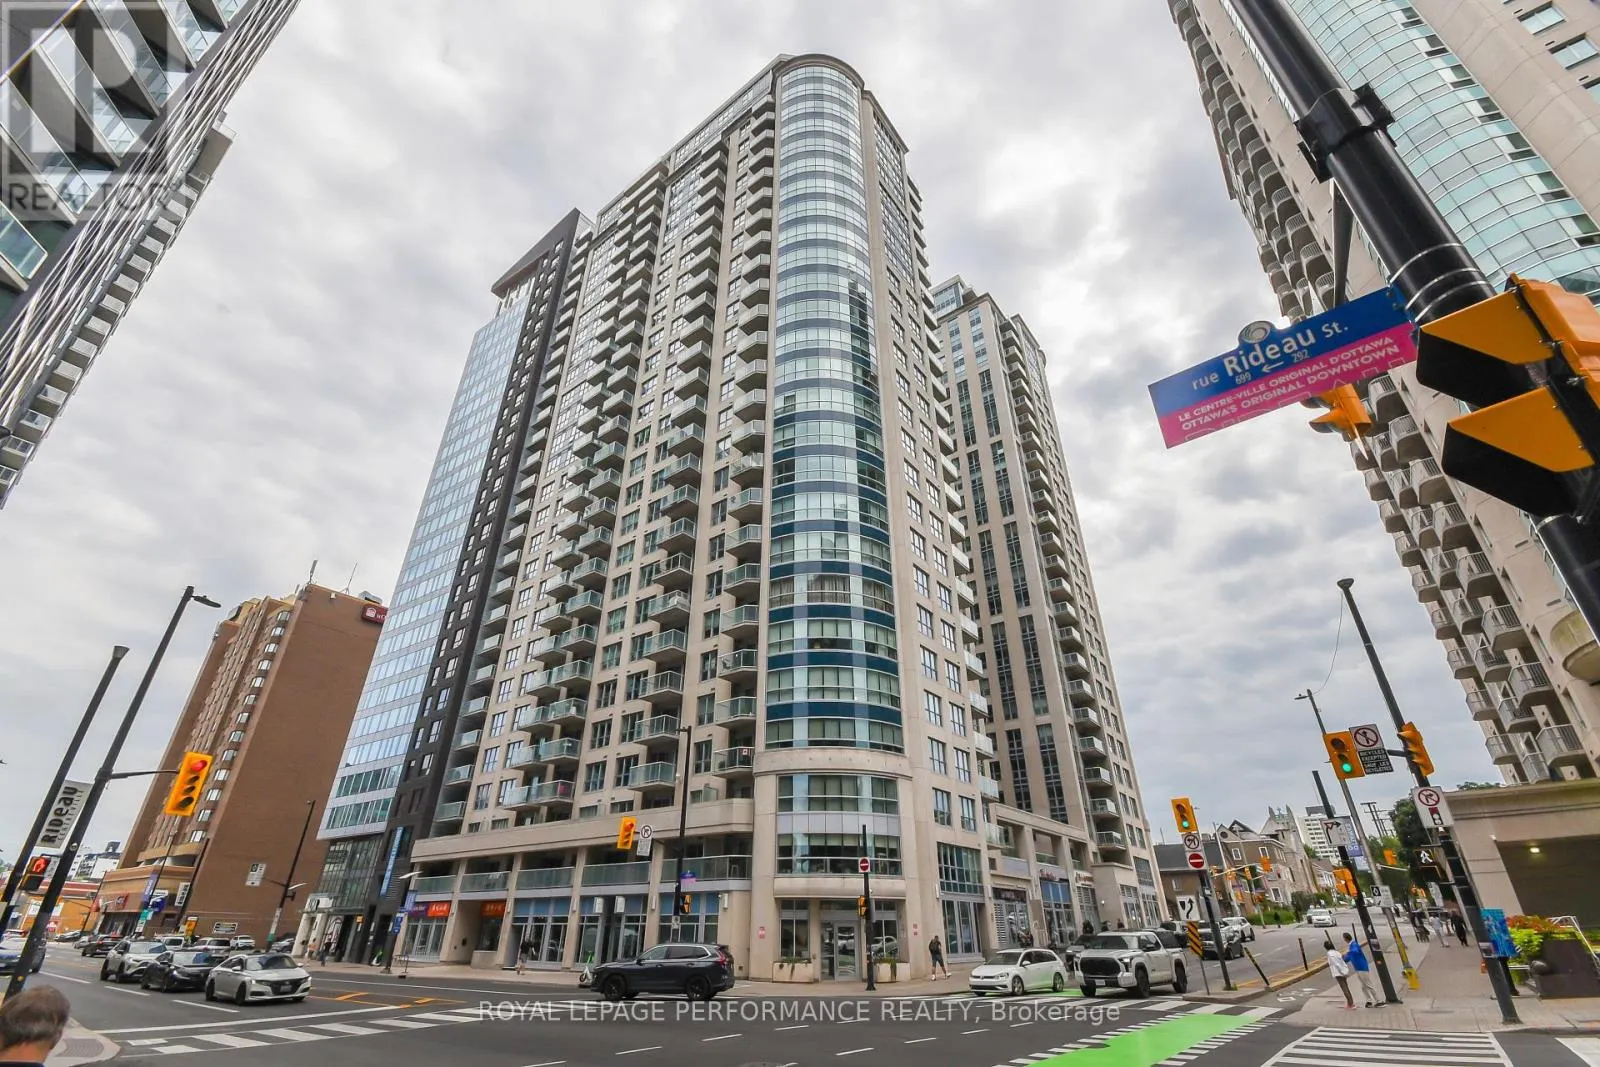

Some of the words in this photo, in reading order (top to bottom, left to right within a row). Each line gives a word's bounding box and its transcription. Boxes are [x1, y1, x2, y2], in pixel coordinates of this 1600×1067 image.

[1177, 412, 1192, 423] LE
[1193, 381, 1267, 418] CENTRE-VILLE
[1268, 360, 1326, 387] ORIGINAL
[1328, 336, 1393, 366] D'OTTAWA
[1181, 407, 1239, 432] OTTAWA'S
[1241, 383, 1305, 409] ORIGINAL
[1306, 345, 1400, 386] DOWNTOWN
[1191, 372, 1219, 391] rue
[1223, 328, 1316, 377] Rideau
[1321, 321, 1349, 339] St.
[1235, 371, 1252, 386] 699
[1292, 349, 1310, 364] 292
